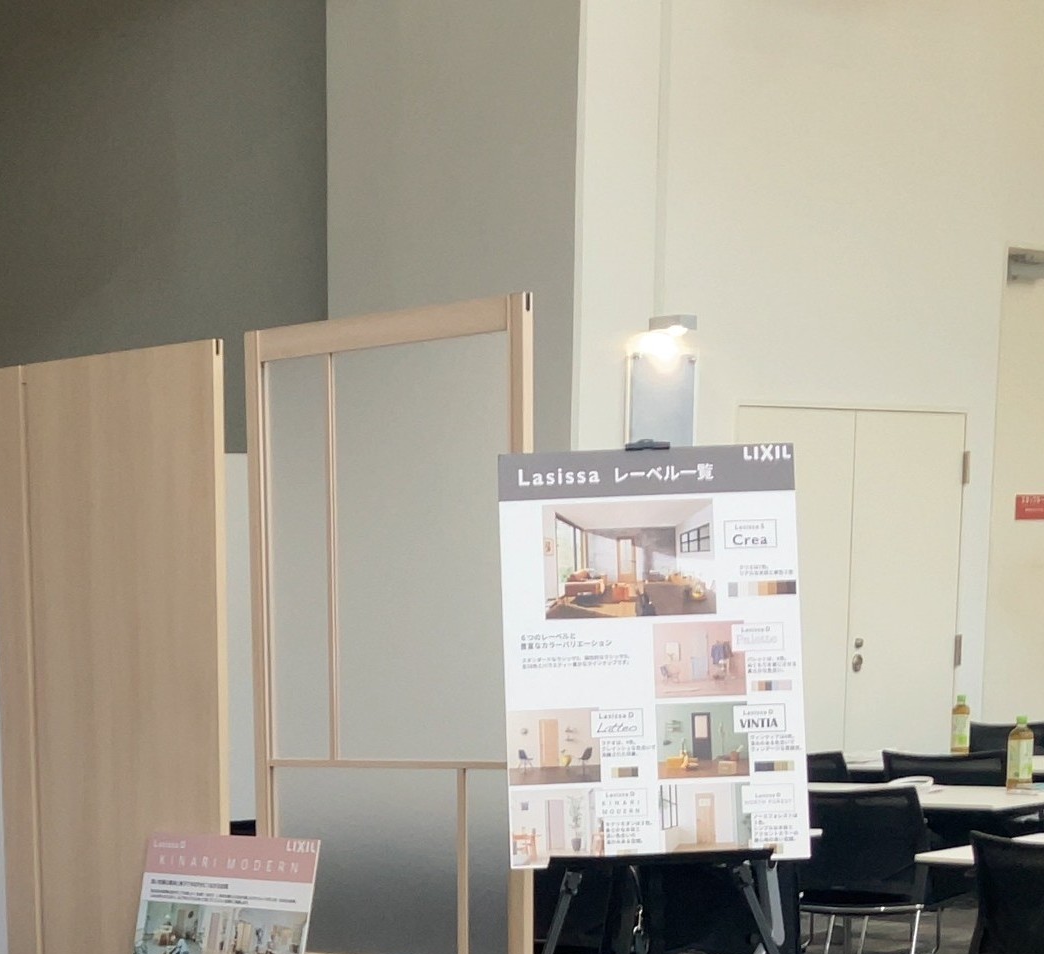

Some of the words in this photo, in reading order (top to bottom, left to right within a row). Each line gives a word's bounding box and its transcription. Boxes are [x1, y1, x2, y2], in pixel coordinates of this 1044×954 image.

[743, 445, 791, 462] LIXIL
[518, 467, 601, 487] Lasissa
[614, 463, 715, 483] レーベル一覧
[732, 534, 768, 546] Crea
[736, 634, 778, 645] Palette
[629, 711, 635, 719] D
[597, 722, 638, 733] Latteo
[739, 718, 779, 729] VINTIA
[286, 840, 317, 853] LIXIL
[159, 854, 218, 867] KINARI
[226, 858, 299, 873] MODERN
